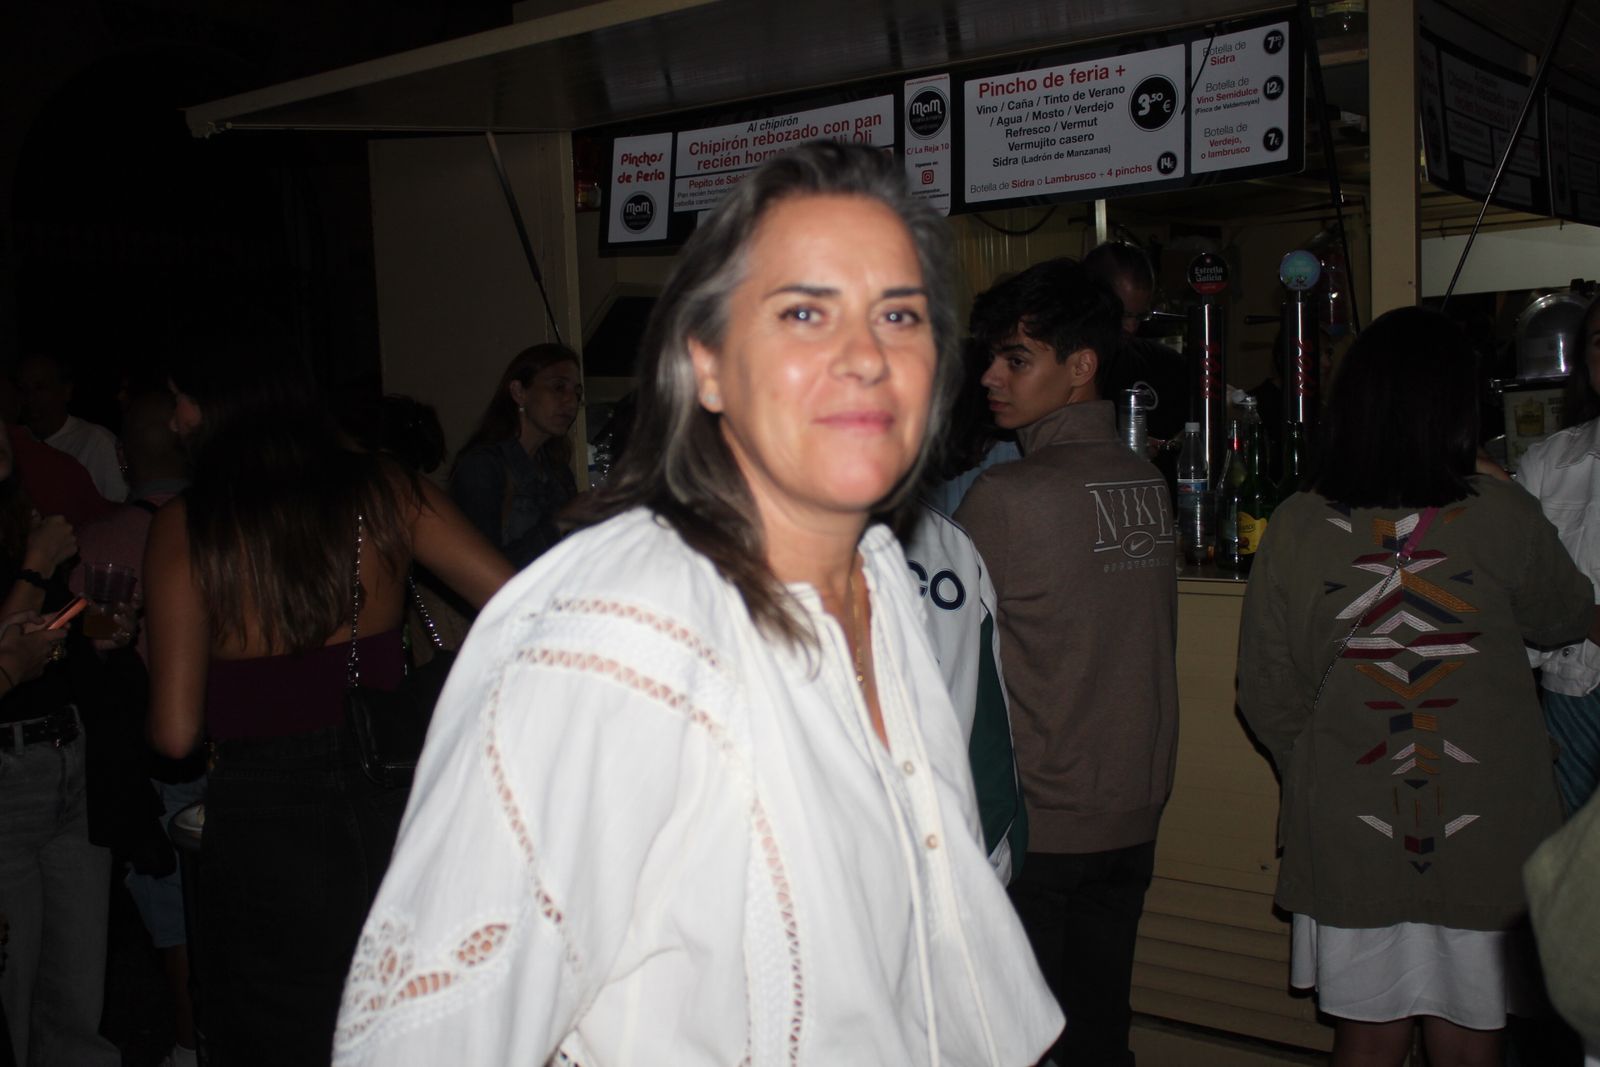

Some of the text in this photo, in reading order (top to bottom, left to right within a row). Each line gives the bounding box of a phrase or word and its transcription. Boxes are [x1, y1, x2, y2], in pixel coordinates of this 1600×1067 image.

[1202, 41, 1247, 57] Botella de
[1210, 54, 1236, 66] Sidra
[979, 65, 1126, 99] Pincho de feria +
[1206, 76, 1249, 93] Botella de
[976, 86, 1125, 115] Vino / Caña / Tinto de Verano
[1196, 87, 1259, 105] Vino Semidulce
[989, 102, 1114, 127] / Agua / Mosto / Verdejo
[1214, 103, 1222, 112] de
[747, 116, 798, 133] Al chipirón
[1005, 117, 1098, 138] Refresco / Vermut
[1204, 122, 1248, 138] Botella de
[689, 114, 882, 156] Chipirón rebozado con pan
[1008, 133, 1095, 151] Vermujito casero
[1209, 136, 1242, 148] Verdejo,
[915, 146, 923, 154] La
[924, 143, 939, 154] Reja
[941, 142, 950, 152] 10
[992, 145, 1111, 168] Sidra (Ladrón de Manzanas)
[1208, 146, 1250, 158] lambrusco
[621, 152, 663, 167] Pinchos
[697, 152, 740, 170] recién
[618, 172, 632, 184] de
[689, 178, 713, 190] Pepito
[715, 176, 725, 186] de
[970, 182, 997, 193] Botella
[999, 180, 1010, 190] de
[1011, 178, 1035, 189] Sidra
[1036, 177, 1043, 186] o
[1045, 172, 1096, 185] Lambrusco
[1107, 168, 1113, 177] 4
[1115, 164, 1153, 178] pinchos
[1089, 485, 1174, 546] NIKE
